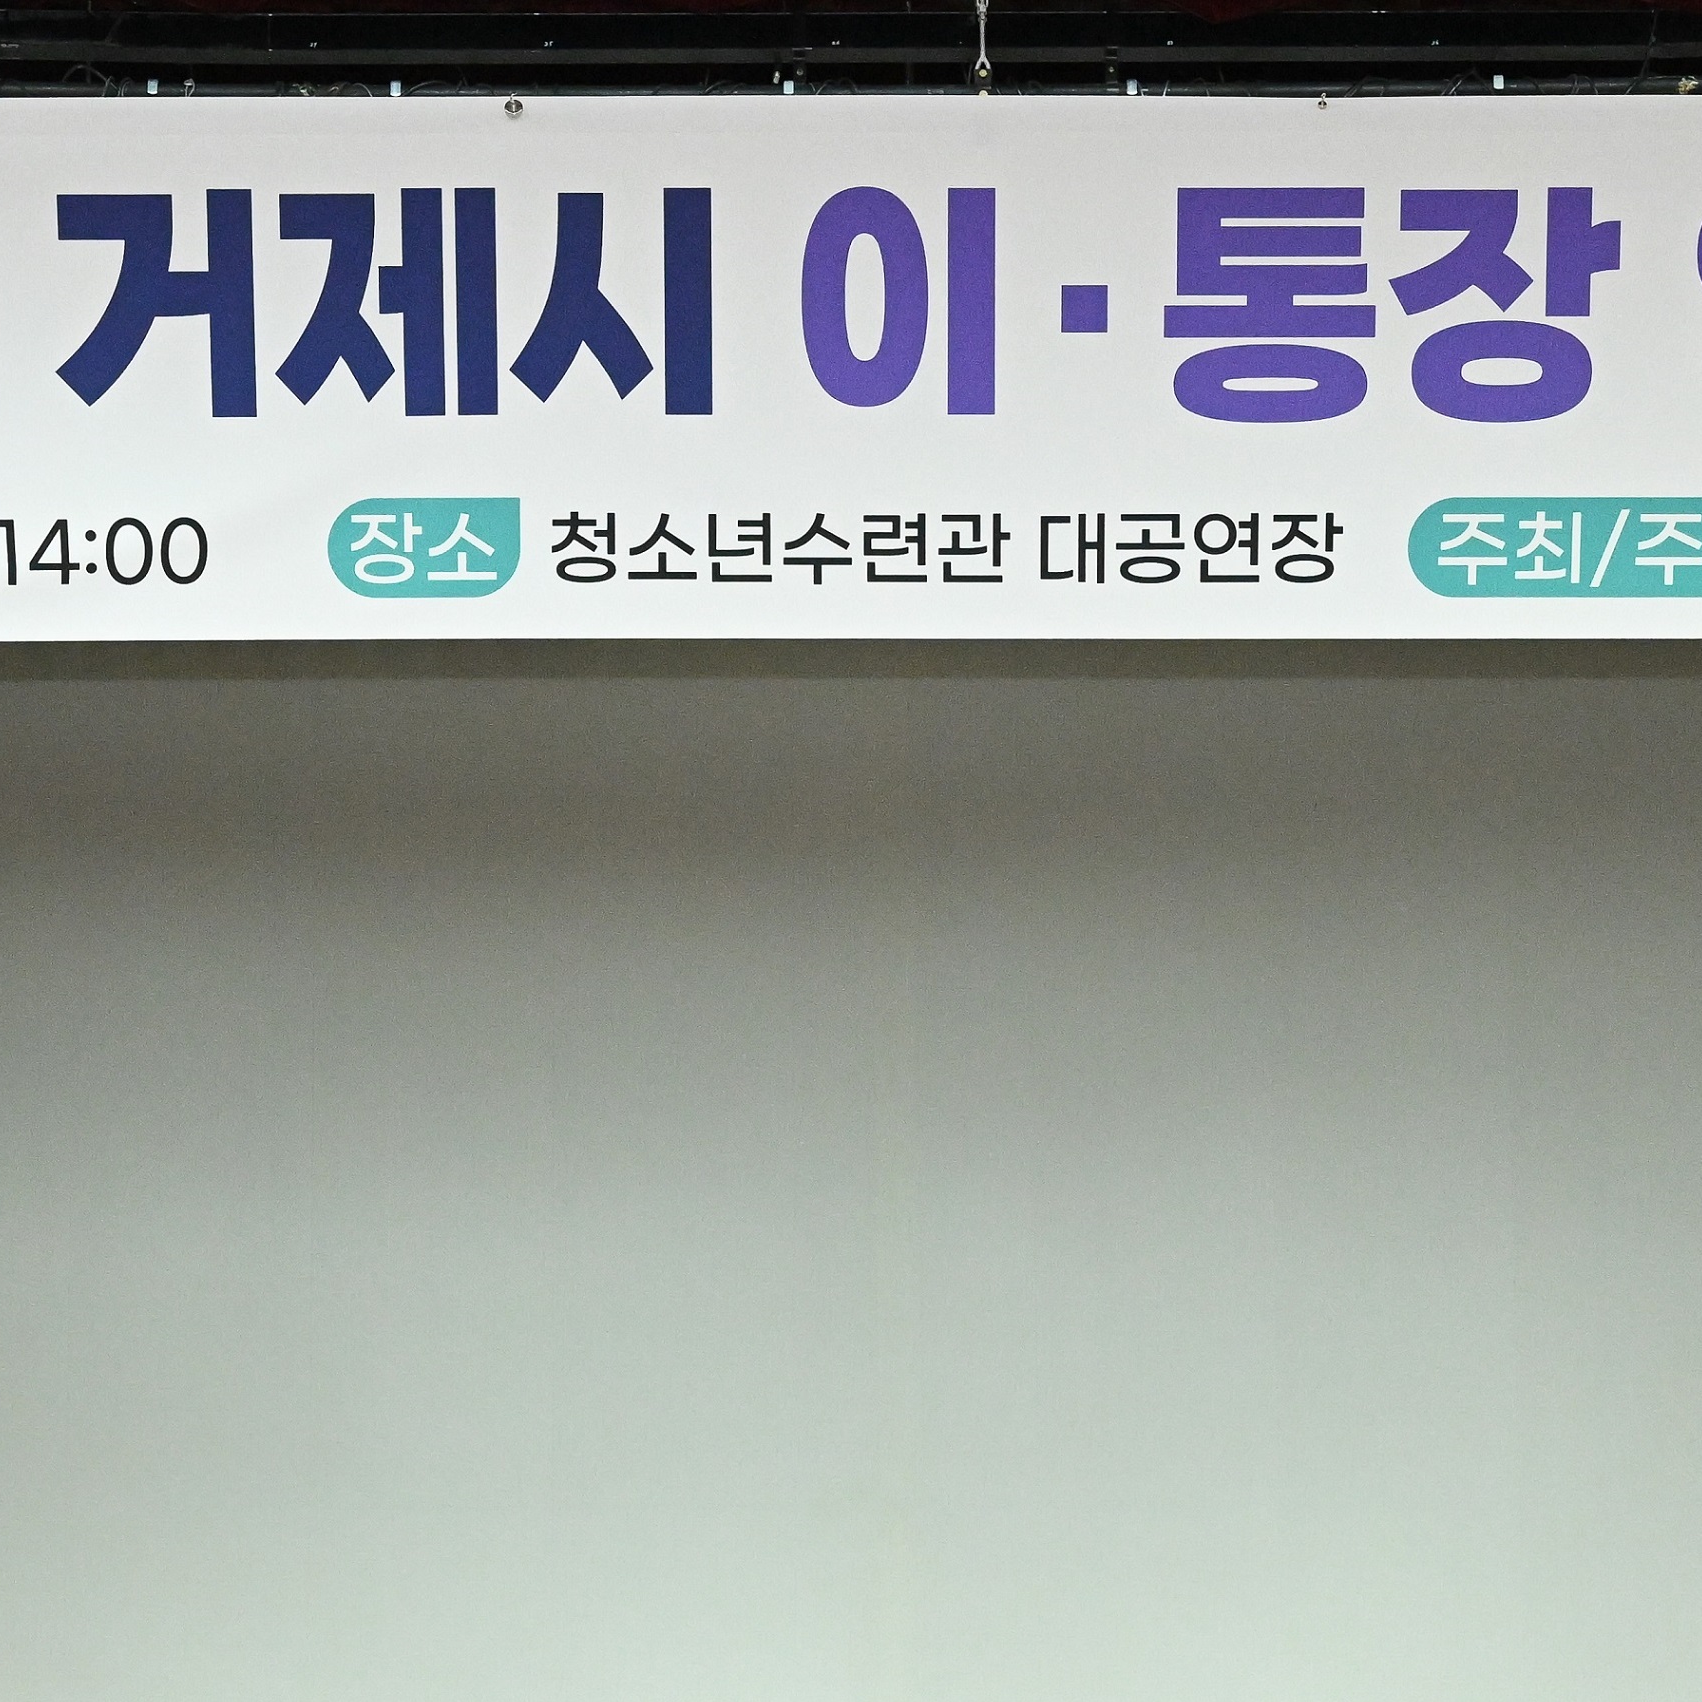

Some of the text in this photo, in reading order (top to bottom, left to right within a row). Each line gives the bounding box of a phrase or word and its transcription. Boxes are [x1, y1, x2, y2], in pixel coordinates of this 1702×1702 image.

[54, 186, 713, 418] 거제시
[349, 511, 499, 583] 장소
[550, 510, 1344, 585] 청소년수련관 대공연장
